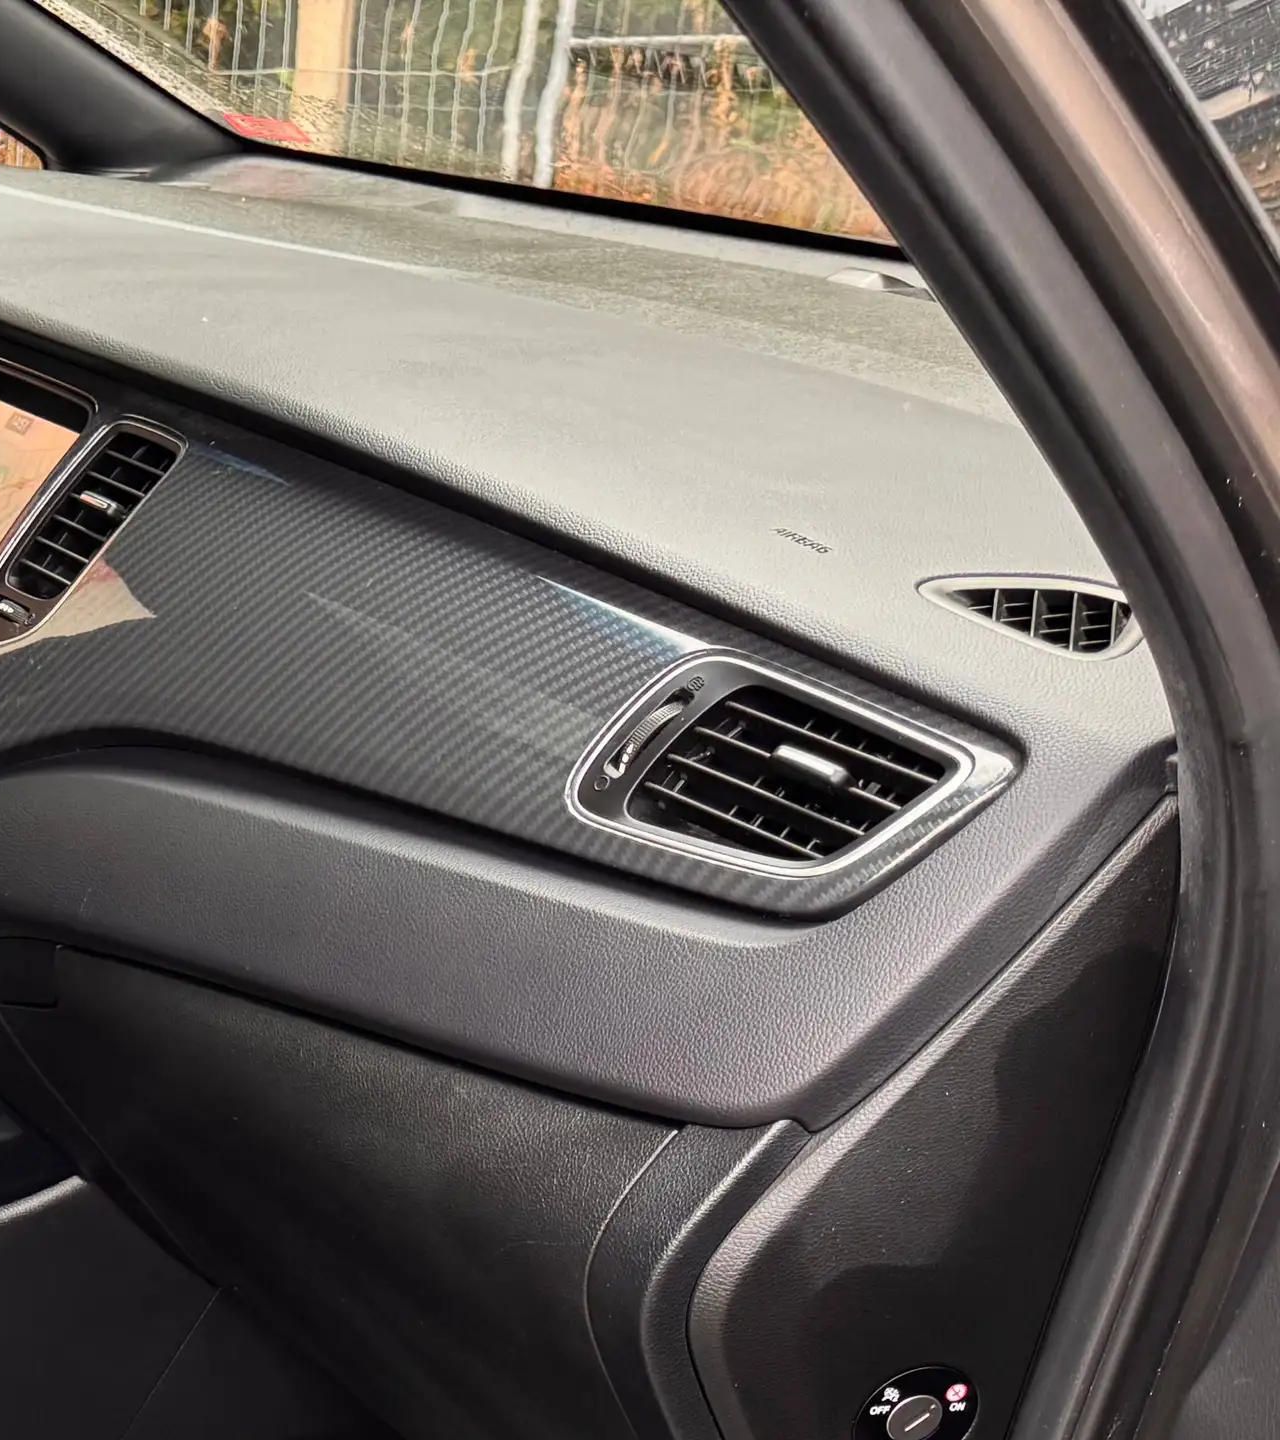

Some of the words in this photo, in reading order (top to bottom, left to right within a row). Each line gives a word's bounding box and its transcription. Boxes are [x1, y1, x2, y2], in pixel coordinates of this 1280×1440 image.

[769, 527, 833, 554] AIRBAG
[869, 1405, 892, 1416] OFF
[949, 1402, 966, 1412] ON
